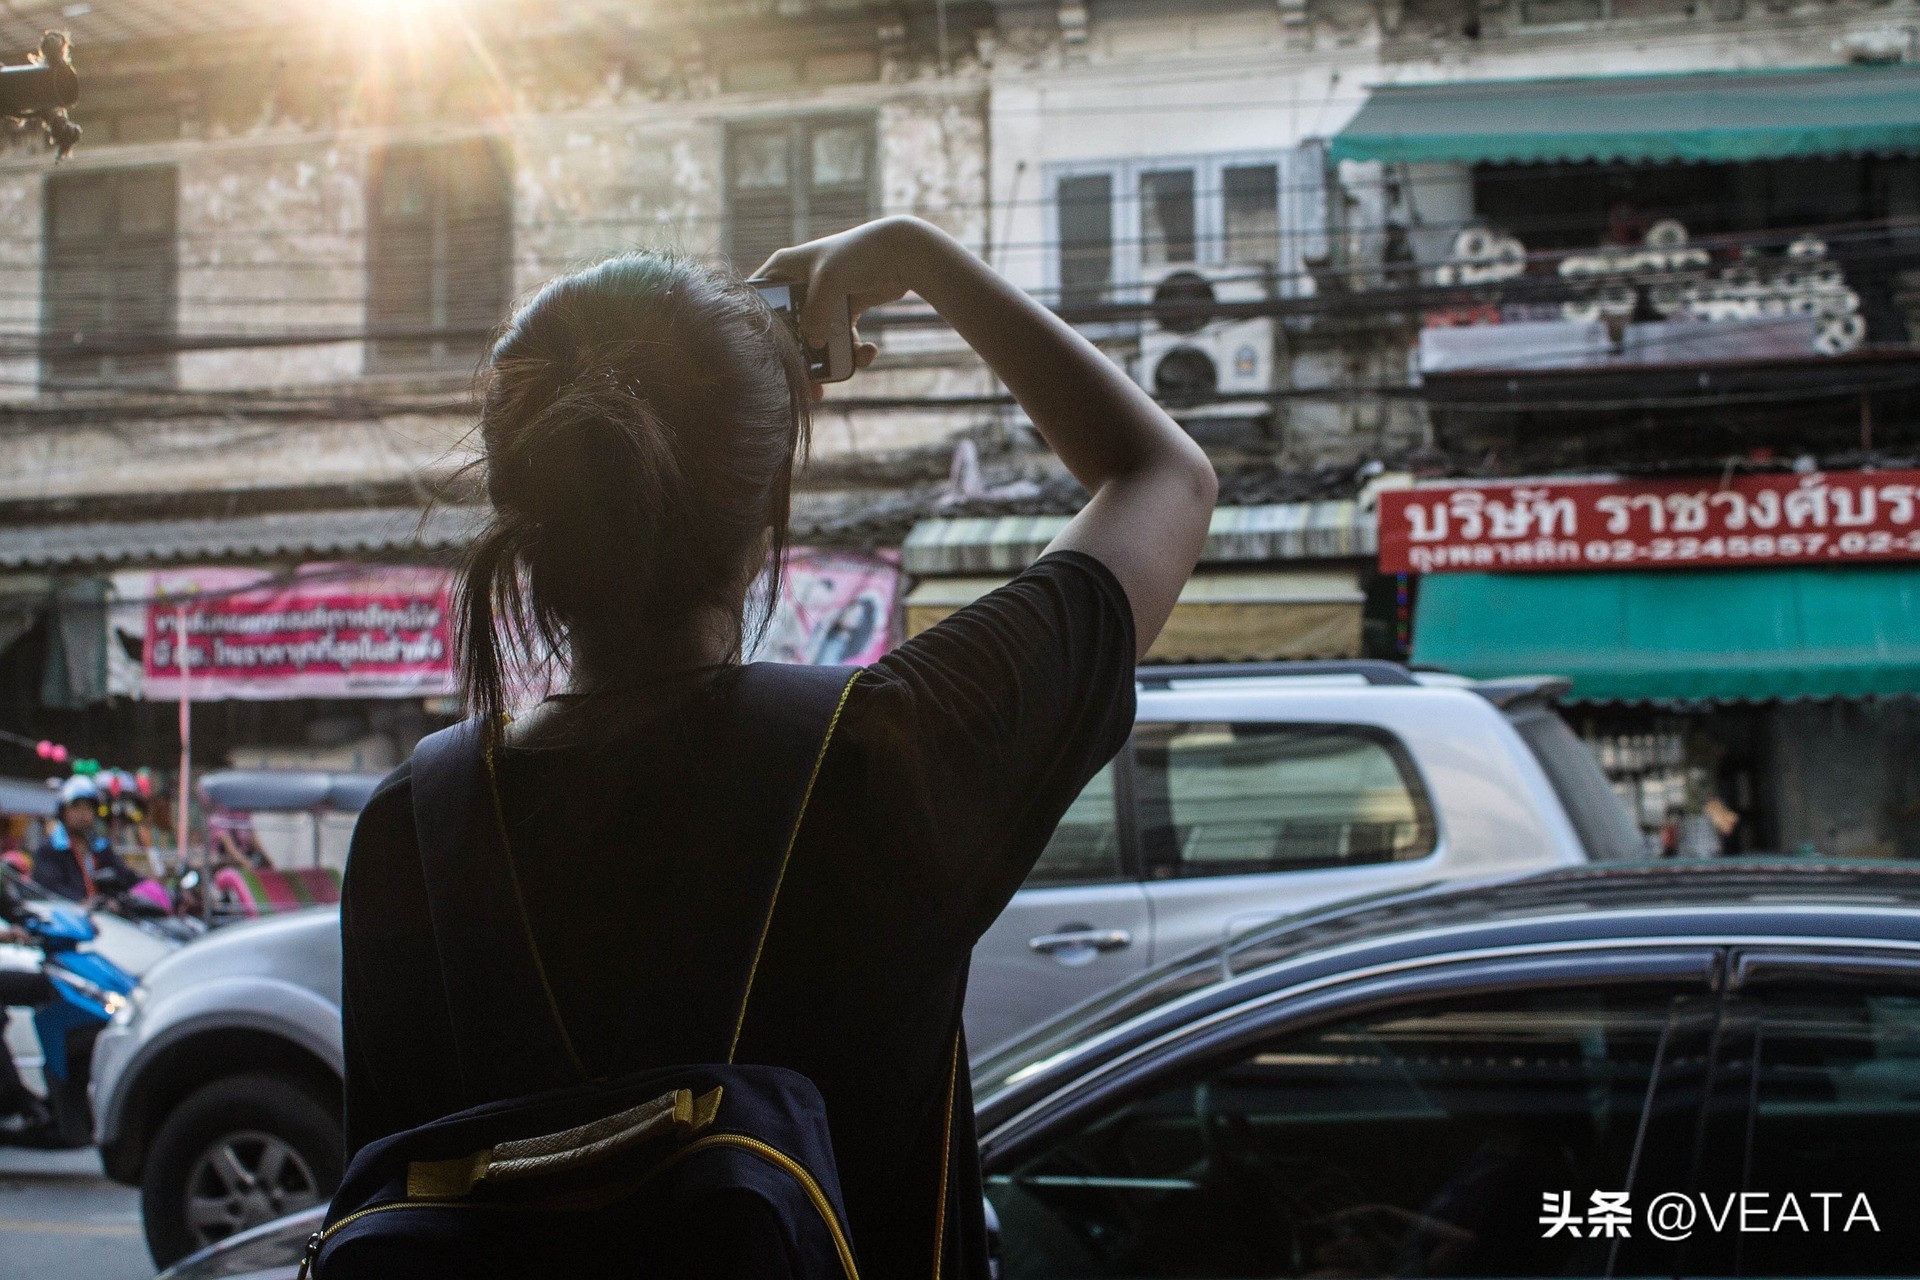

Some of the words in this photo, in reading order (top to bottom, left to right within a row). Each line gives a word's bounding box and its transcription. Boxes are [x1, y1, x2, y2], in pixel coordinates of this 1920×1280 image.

[1404, 488, 1578, 542] บริษัท
[1595, 473, 1920, 535] ราชวงศ์บร
[1407, 538, 1581, 573] ถุงพลาสติก
